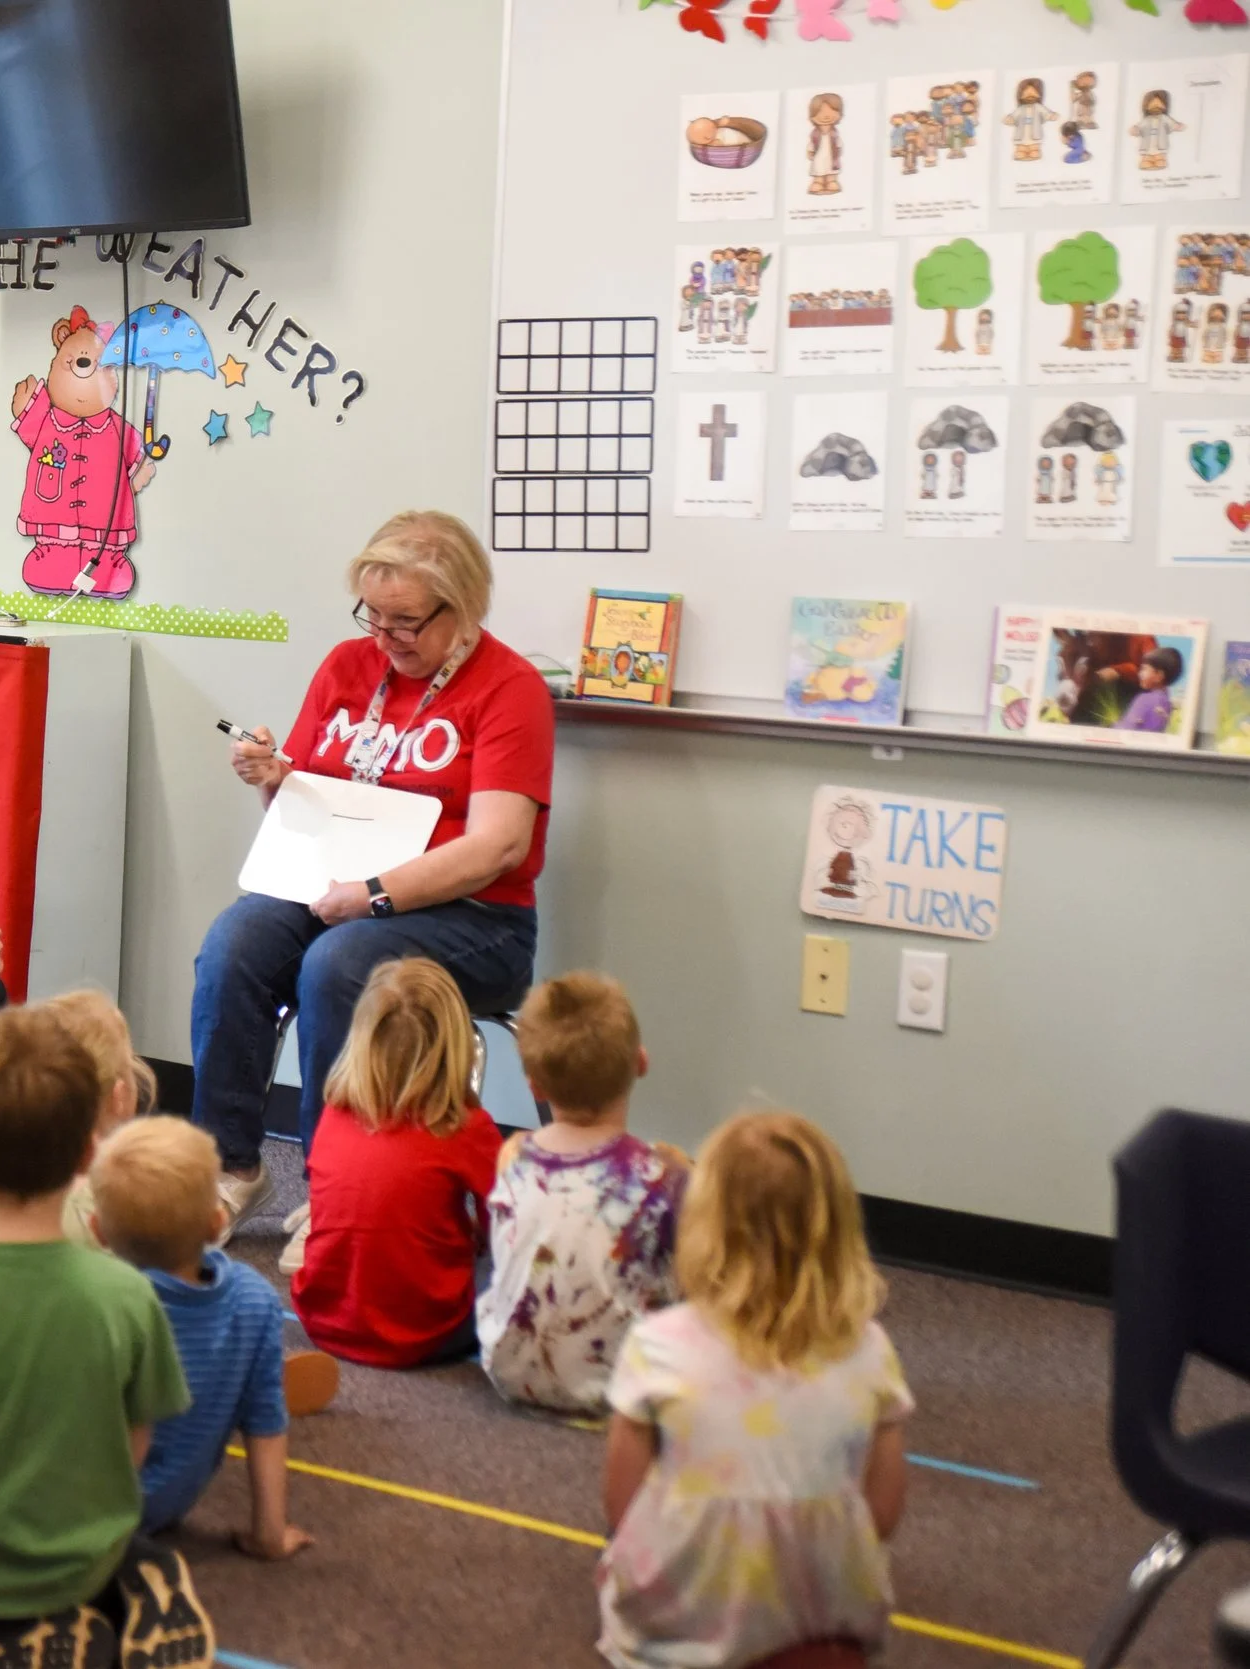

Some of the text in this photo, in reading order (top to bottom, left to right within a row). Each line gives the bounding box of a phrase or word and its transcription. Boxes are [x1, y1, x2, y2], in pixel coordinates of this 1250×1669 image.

[96, 232, 365, 424] WEATHER?
[880, 802, 1006, 874] TAKE
[885, 881, 997, 937] TURNS
